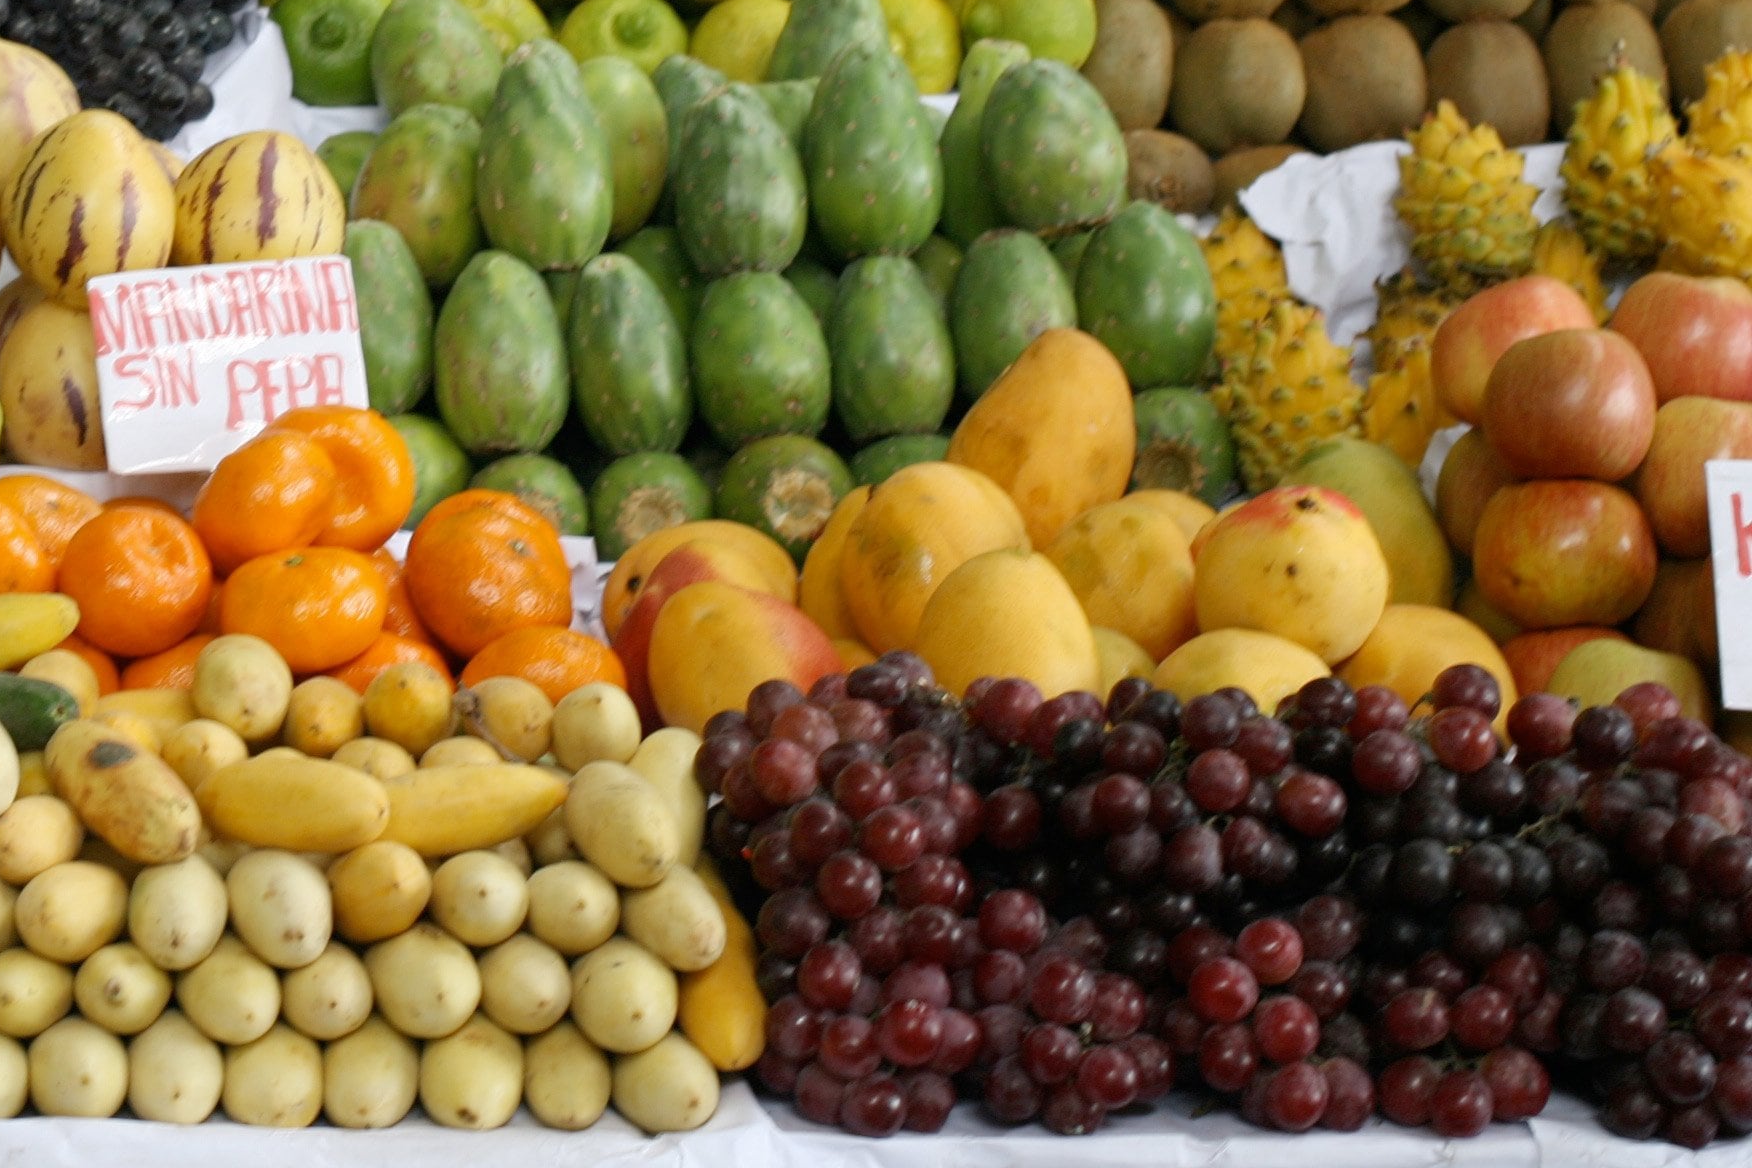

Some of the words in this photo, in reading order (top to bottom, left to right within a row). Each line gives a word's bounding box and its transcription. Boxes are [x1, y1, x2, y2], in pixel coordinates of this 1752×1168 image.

[87, 260, 359, 358] MANDARINA
[112, 347, 200, 409] SIN
[226, 352, 344, 431] PEPA
